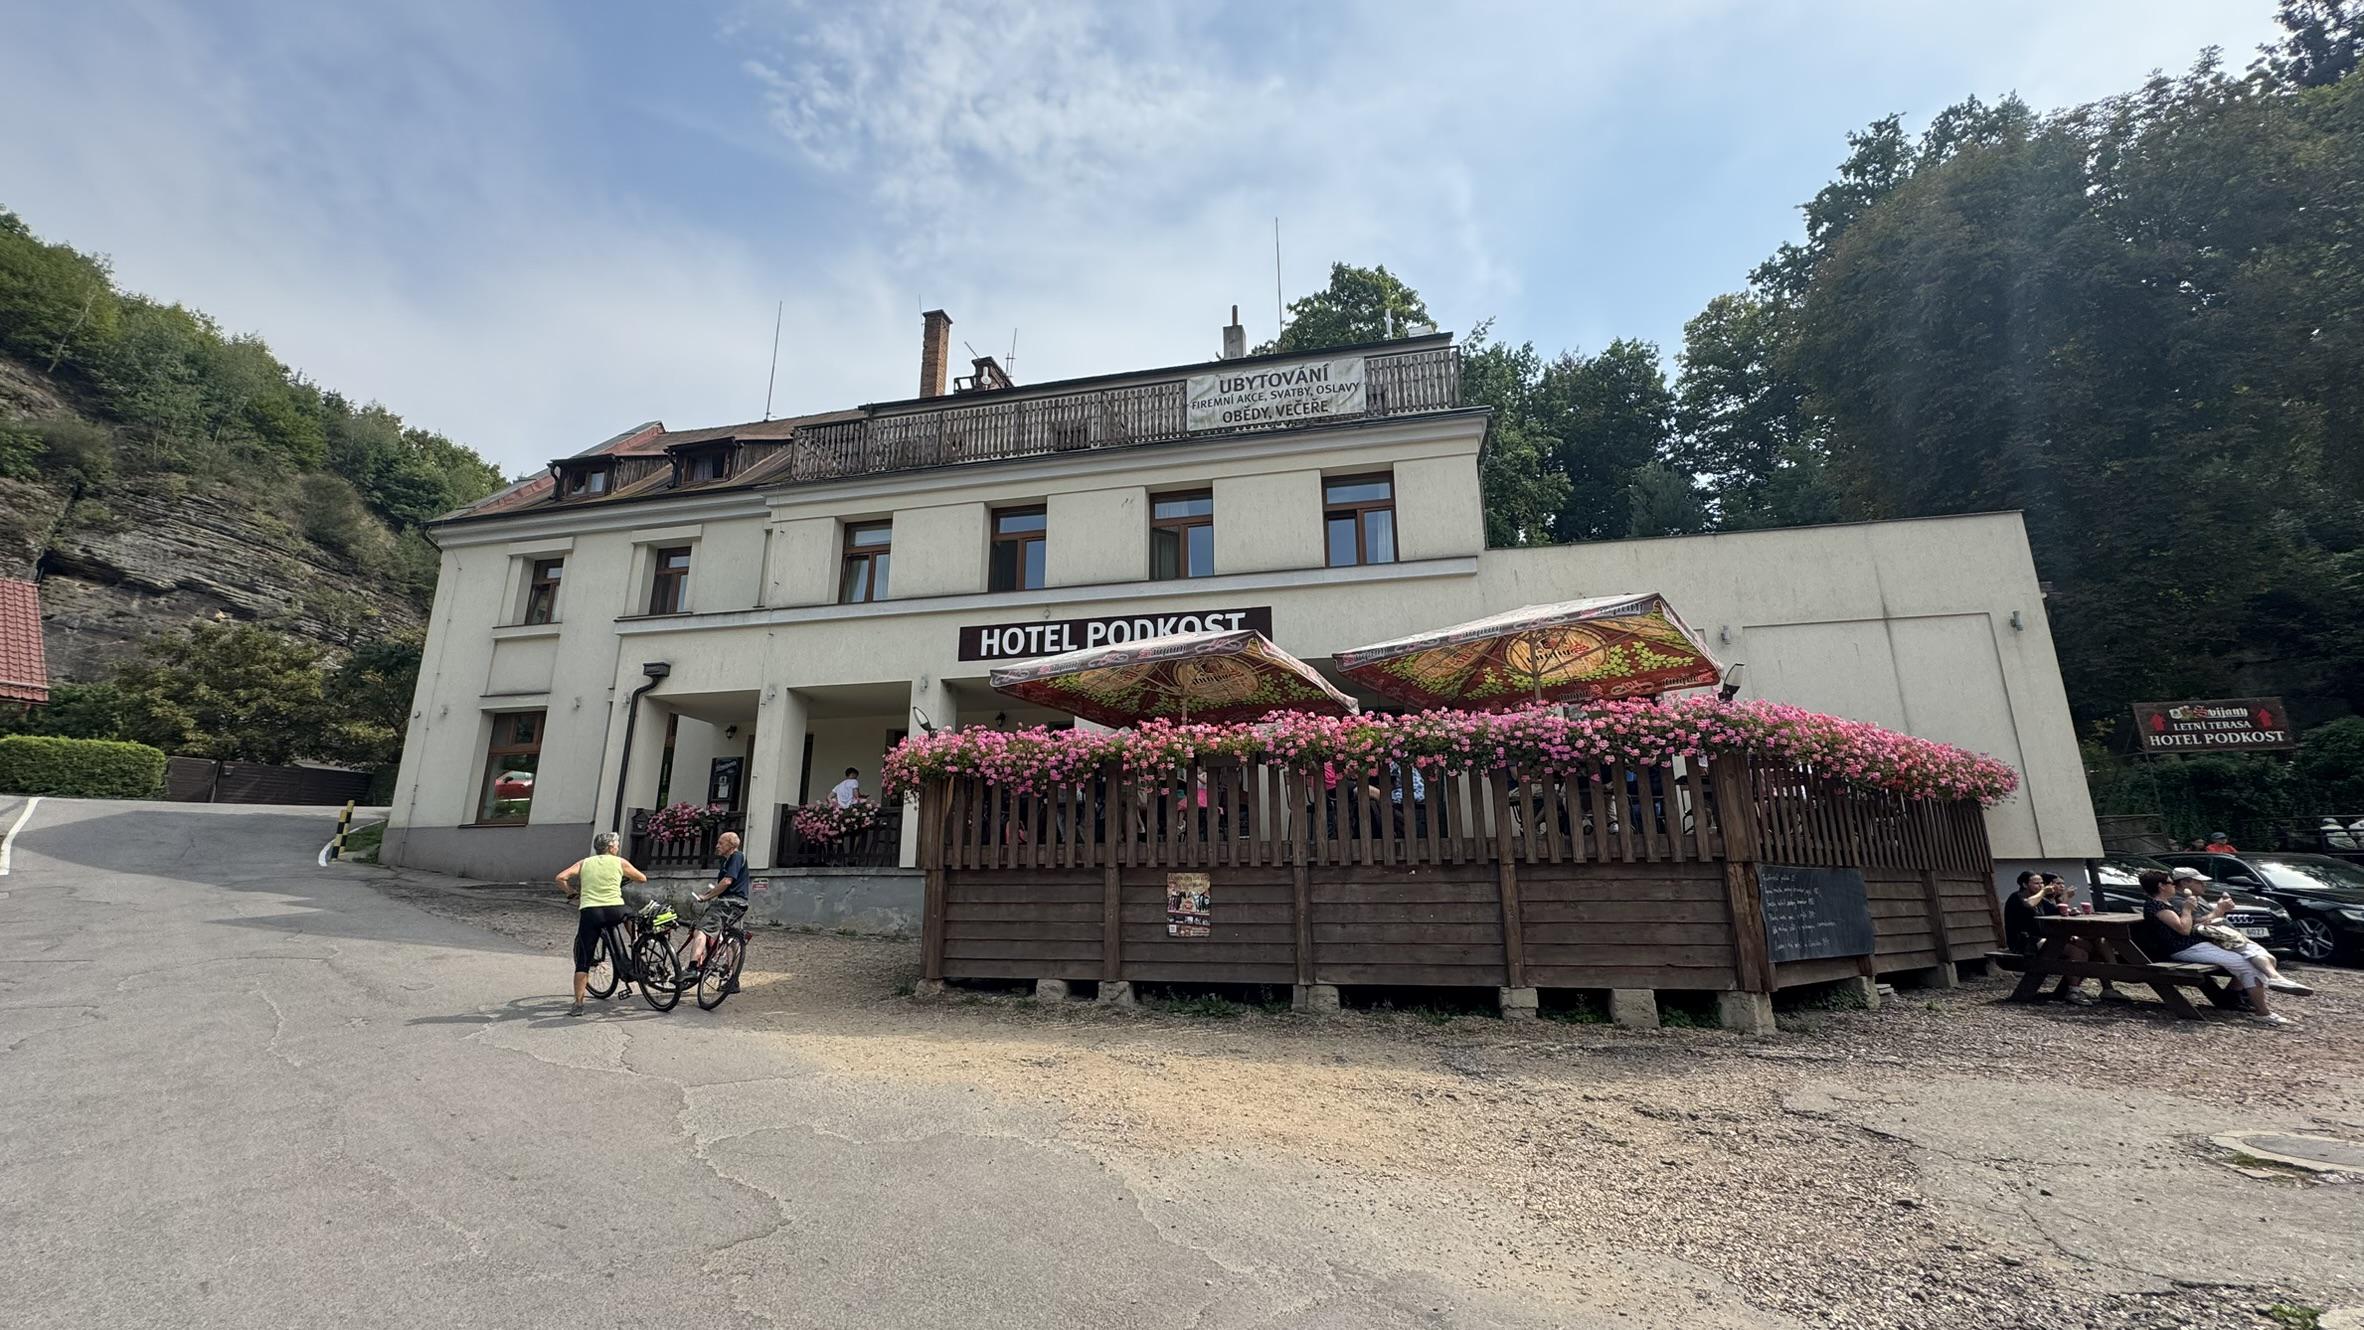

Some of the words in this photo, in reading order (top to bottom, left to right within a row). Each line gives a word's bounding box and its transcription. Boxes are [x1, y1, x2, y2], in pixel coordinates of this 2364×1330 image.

[1220, 364, 1329, 394] UBYTOVÁNÍ
[1192, 393, 1235, 410] FIREMNÍ
[1236, 392, 1268, 404] AKCE,
[1270, 386, 1314, 400] SVATBY,
[1316, 382, 1360, 395] OSLAVY
[1222, 405, 1272, 424] OBĚDY,
[1275, 397, 1329, 418] VEČEŘE
[980, 624, 1078, 656] HOTEL
[1087, 612, 1246, 648] PODKOST
[2150, 734, 2202, 746] HOTEL
[2204, 731, 2284, 744] PODKOST
[2173, 721, 2206, 731] LETNÍ
[2210, 720, 2251, 729] TERASA
